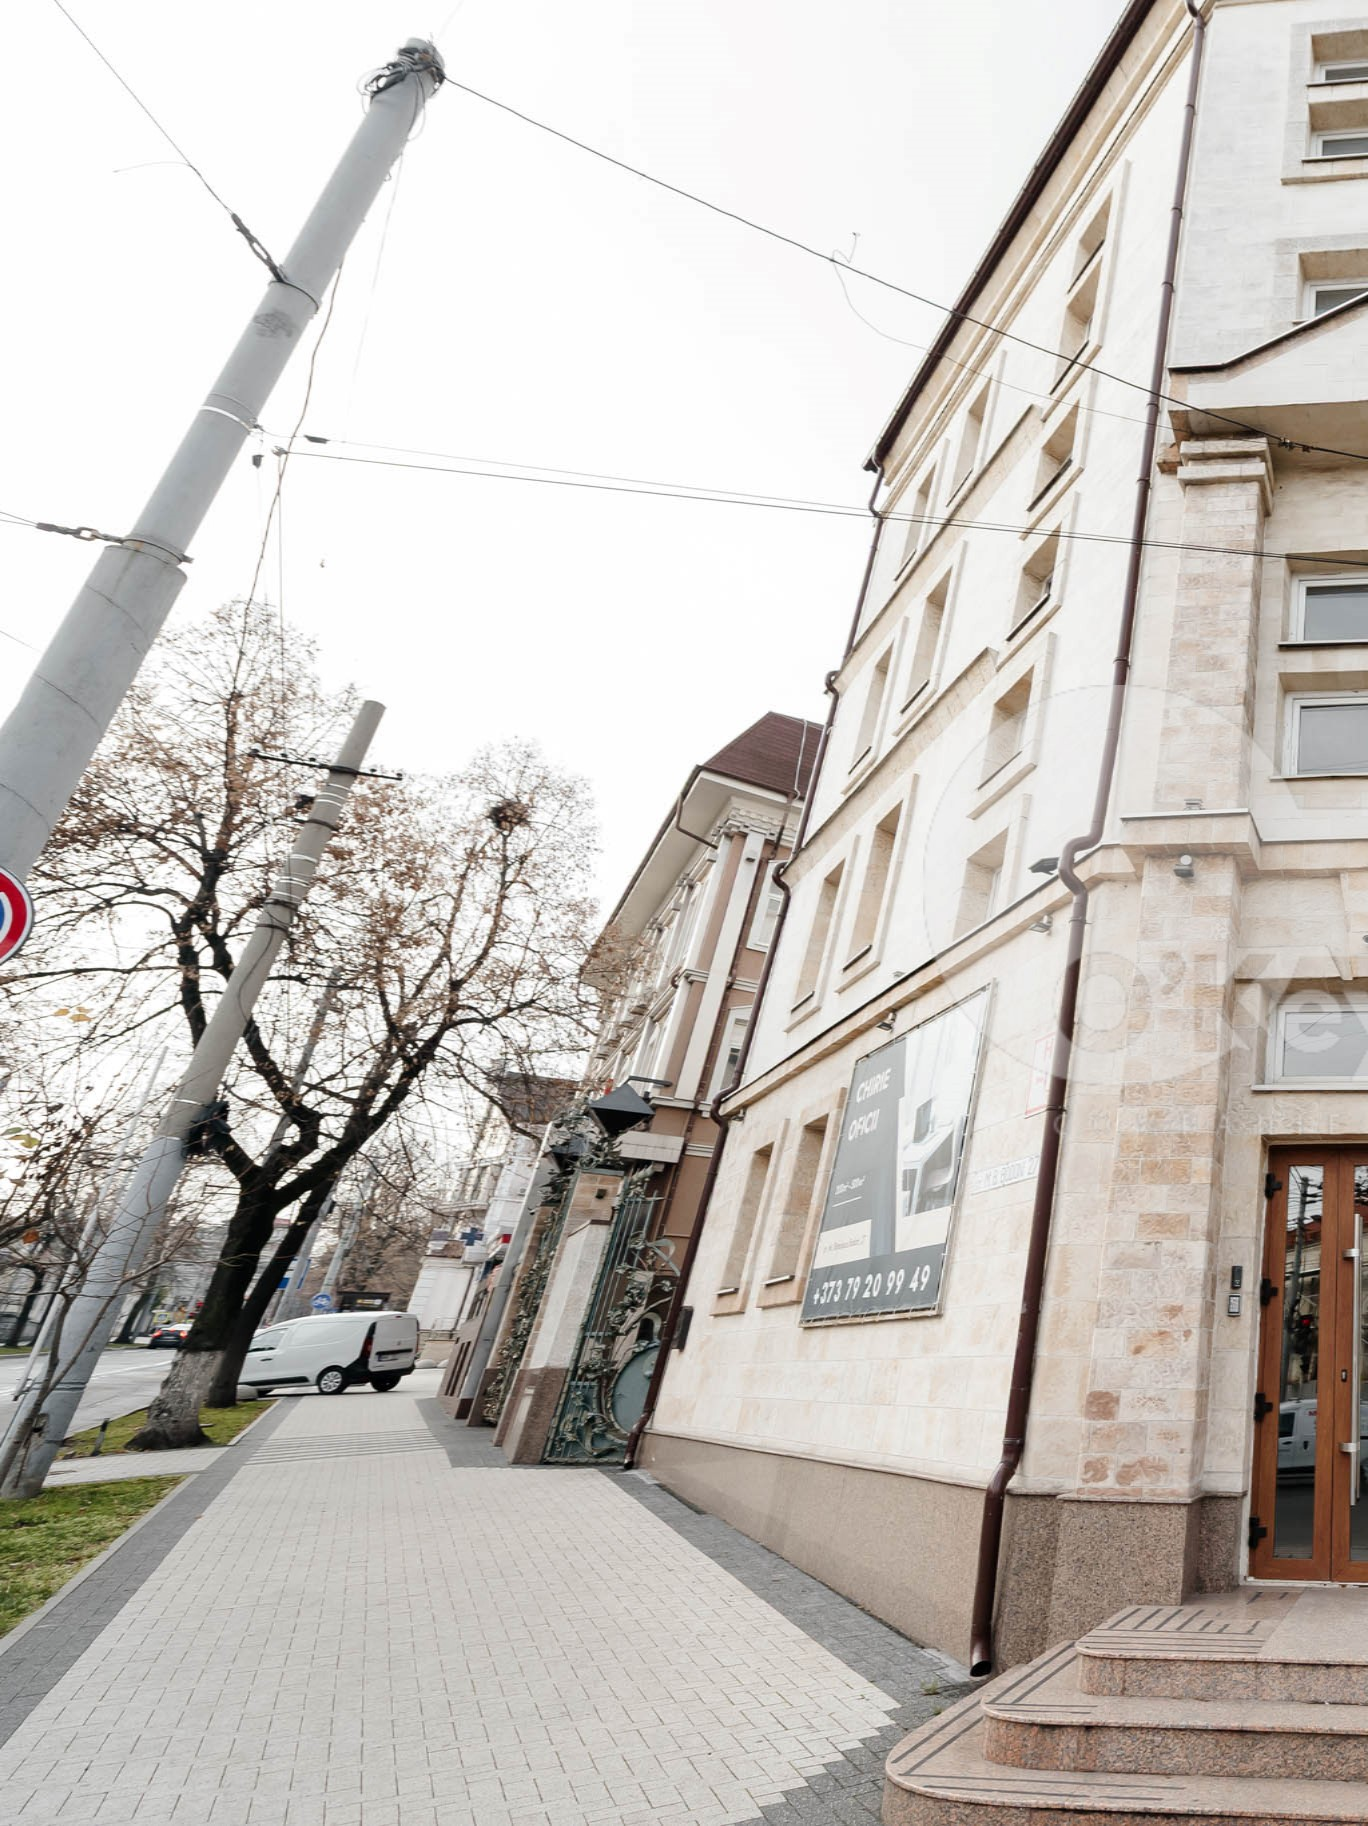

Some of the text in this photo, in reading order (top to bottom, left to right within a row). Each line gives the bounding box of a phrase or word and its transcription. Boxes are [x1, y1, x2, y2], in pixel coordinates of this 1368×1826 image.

[856, 1067, 892, 1103] CHIRIE
[848, 1108, 880, 1141] OFICII
[813, 1264, 931, 1305] +373 79 20 99 49
